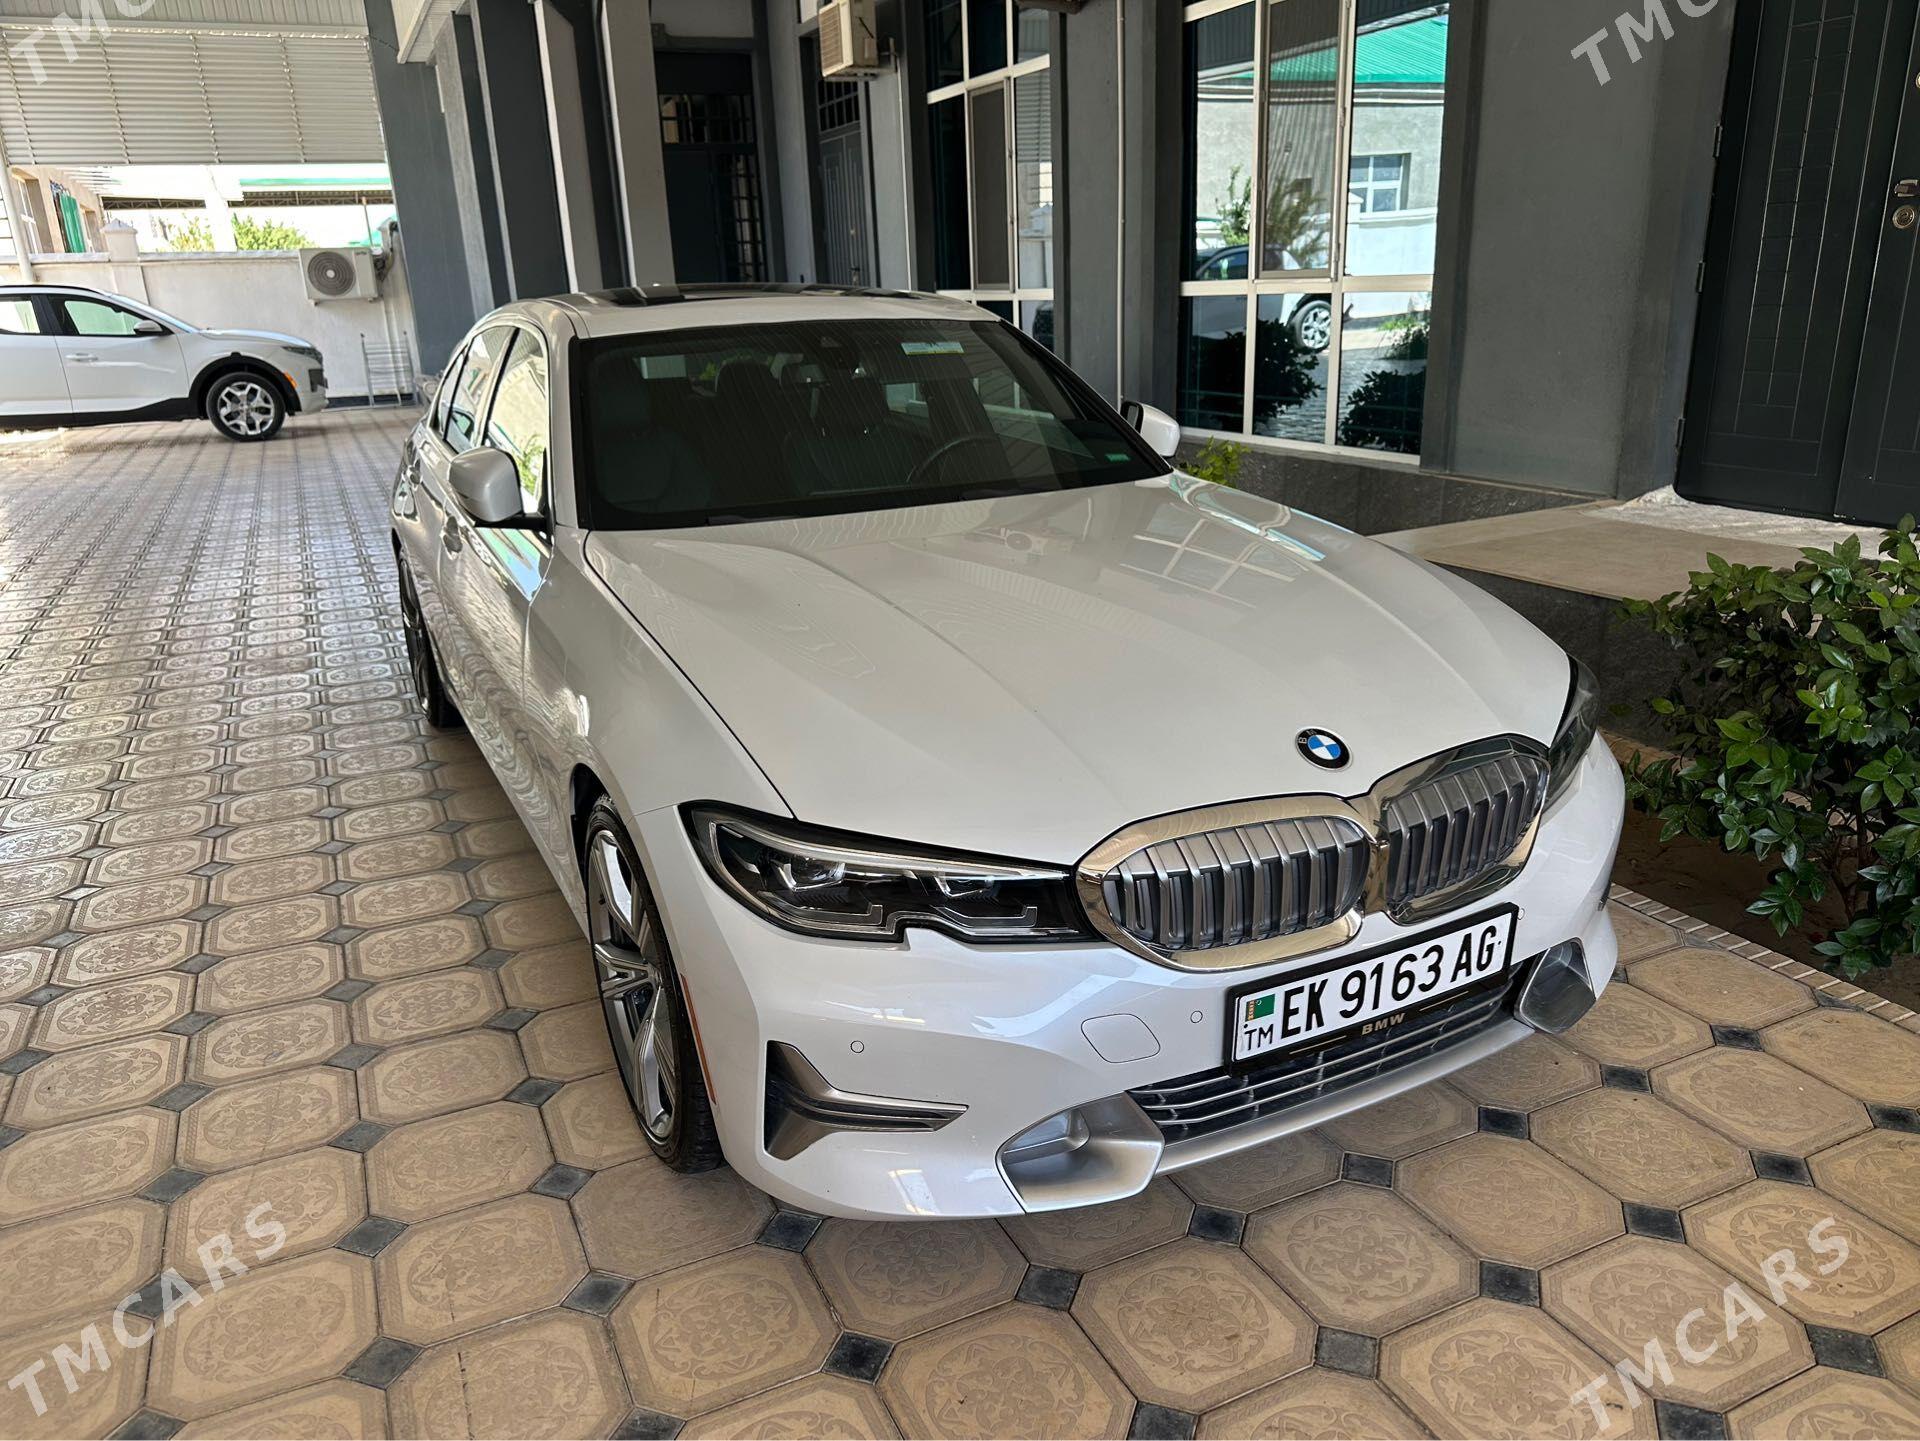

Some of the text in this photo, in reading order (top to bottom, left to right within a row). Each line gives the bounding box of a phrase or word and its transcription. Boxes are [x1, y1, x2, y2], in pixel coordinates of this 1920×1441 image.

[1280, 925, 1497, 1039] EK 9163 AG
[1243, 1023, 1275, 1051] TM
[1361, 1013, 1406, 1036] BMW
